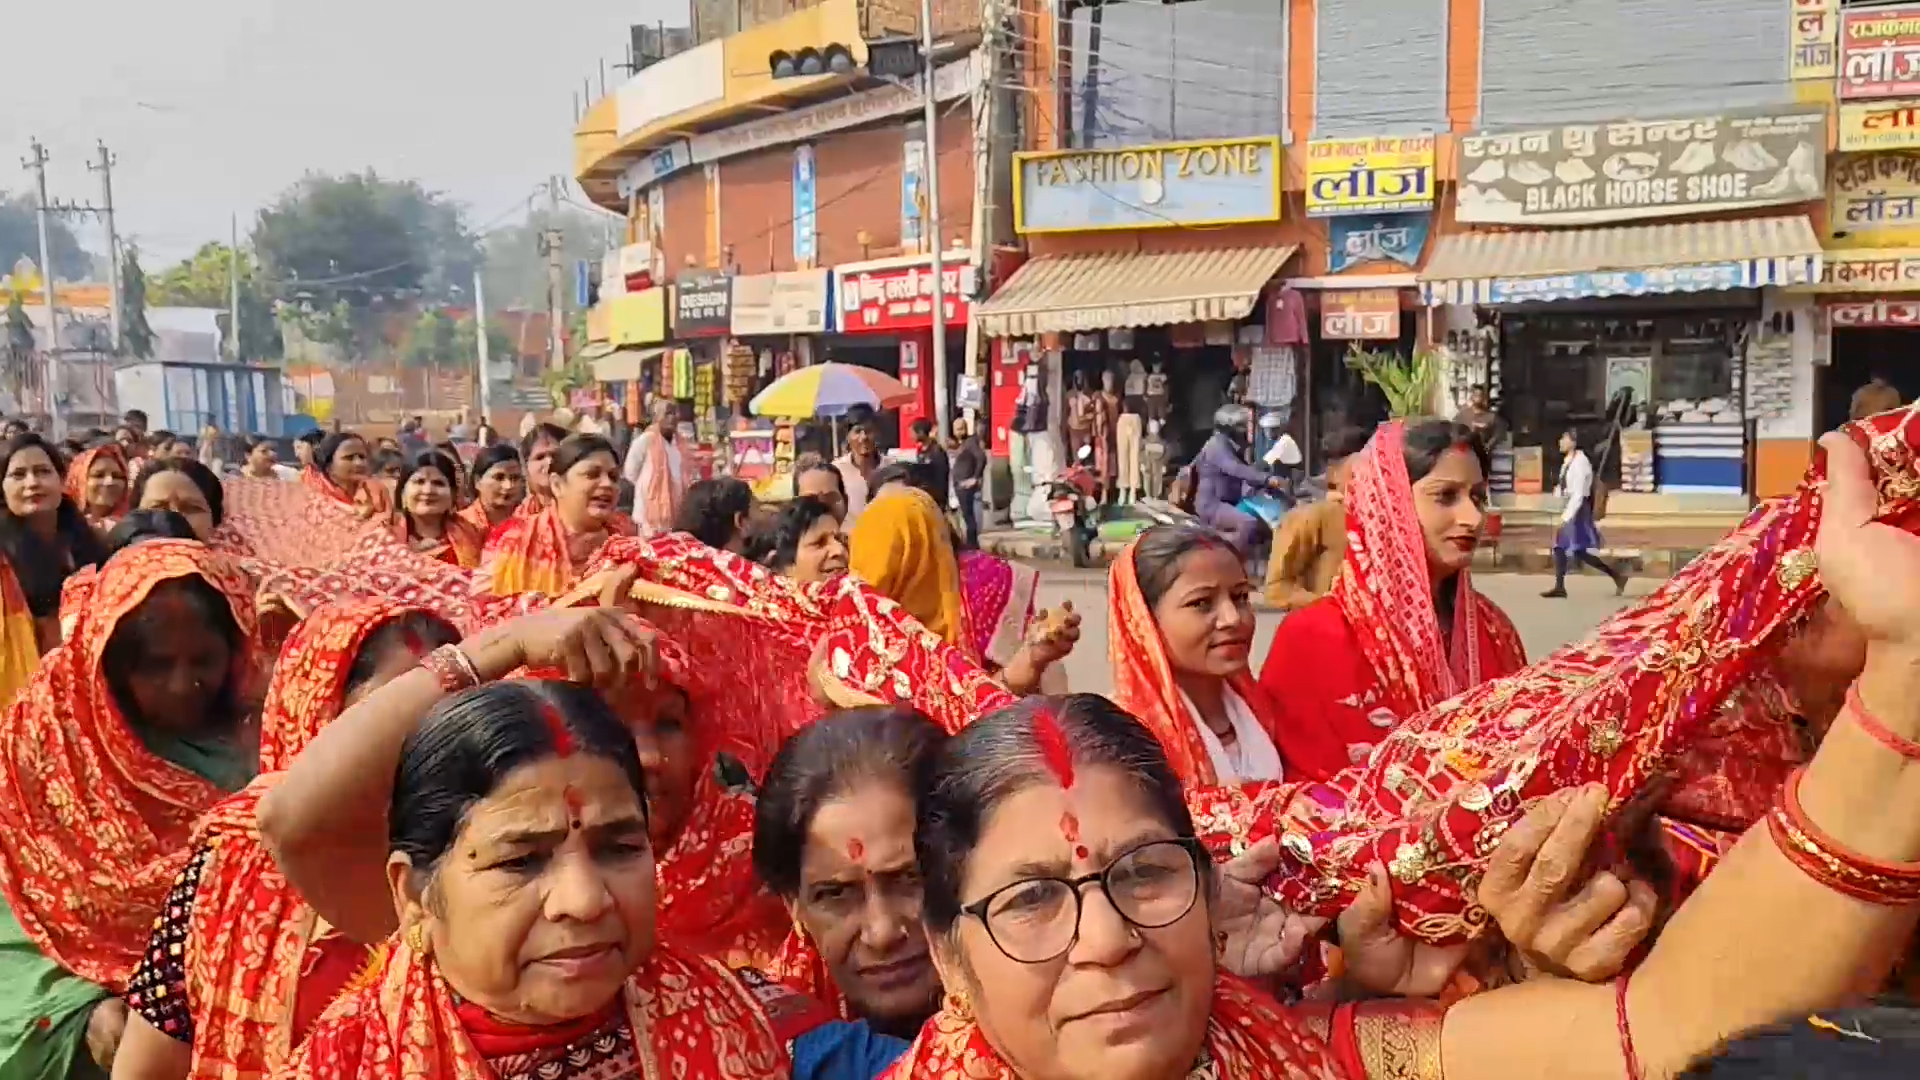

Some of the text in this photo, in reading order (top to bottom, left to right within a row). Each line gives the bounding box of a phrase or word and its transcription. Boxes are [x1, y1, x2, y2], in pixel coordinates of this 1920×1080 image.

[1462, 131, 1552, 157] रंजन
[1037, 144, 1262, 187] FASHION ZONE
[1526, 173, 1748, 212] BLACK HORSE SHOE
